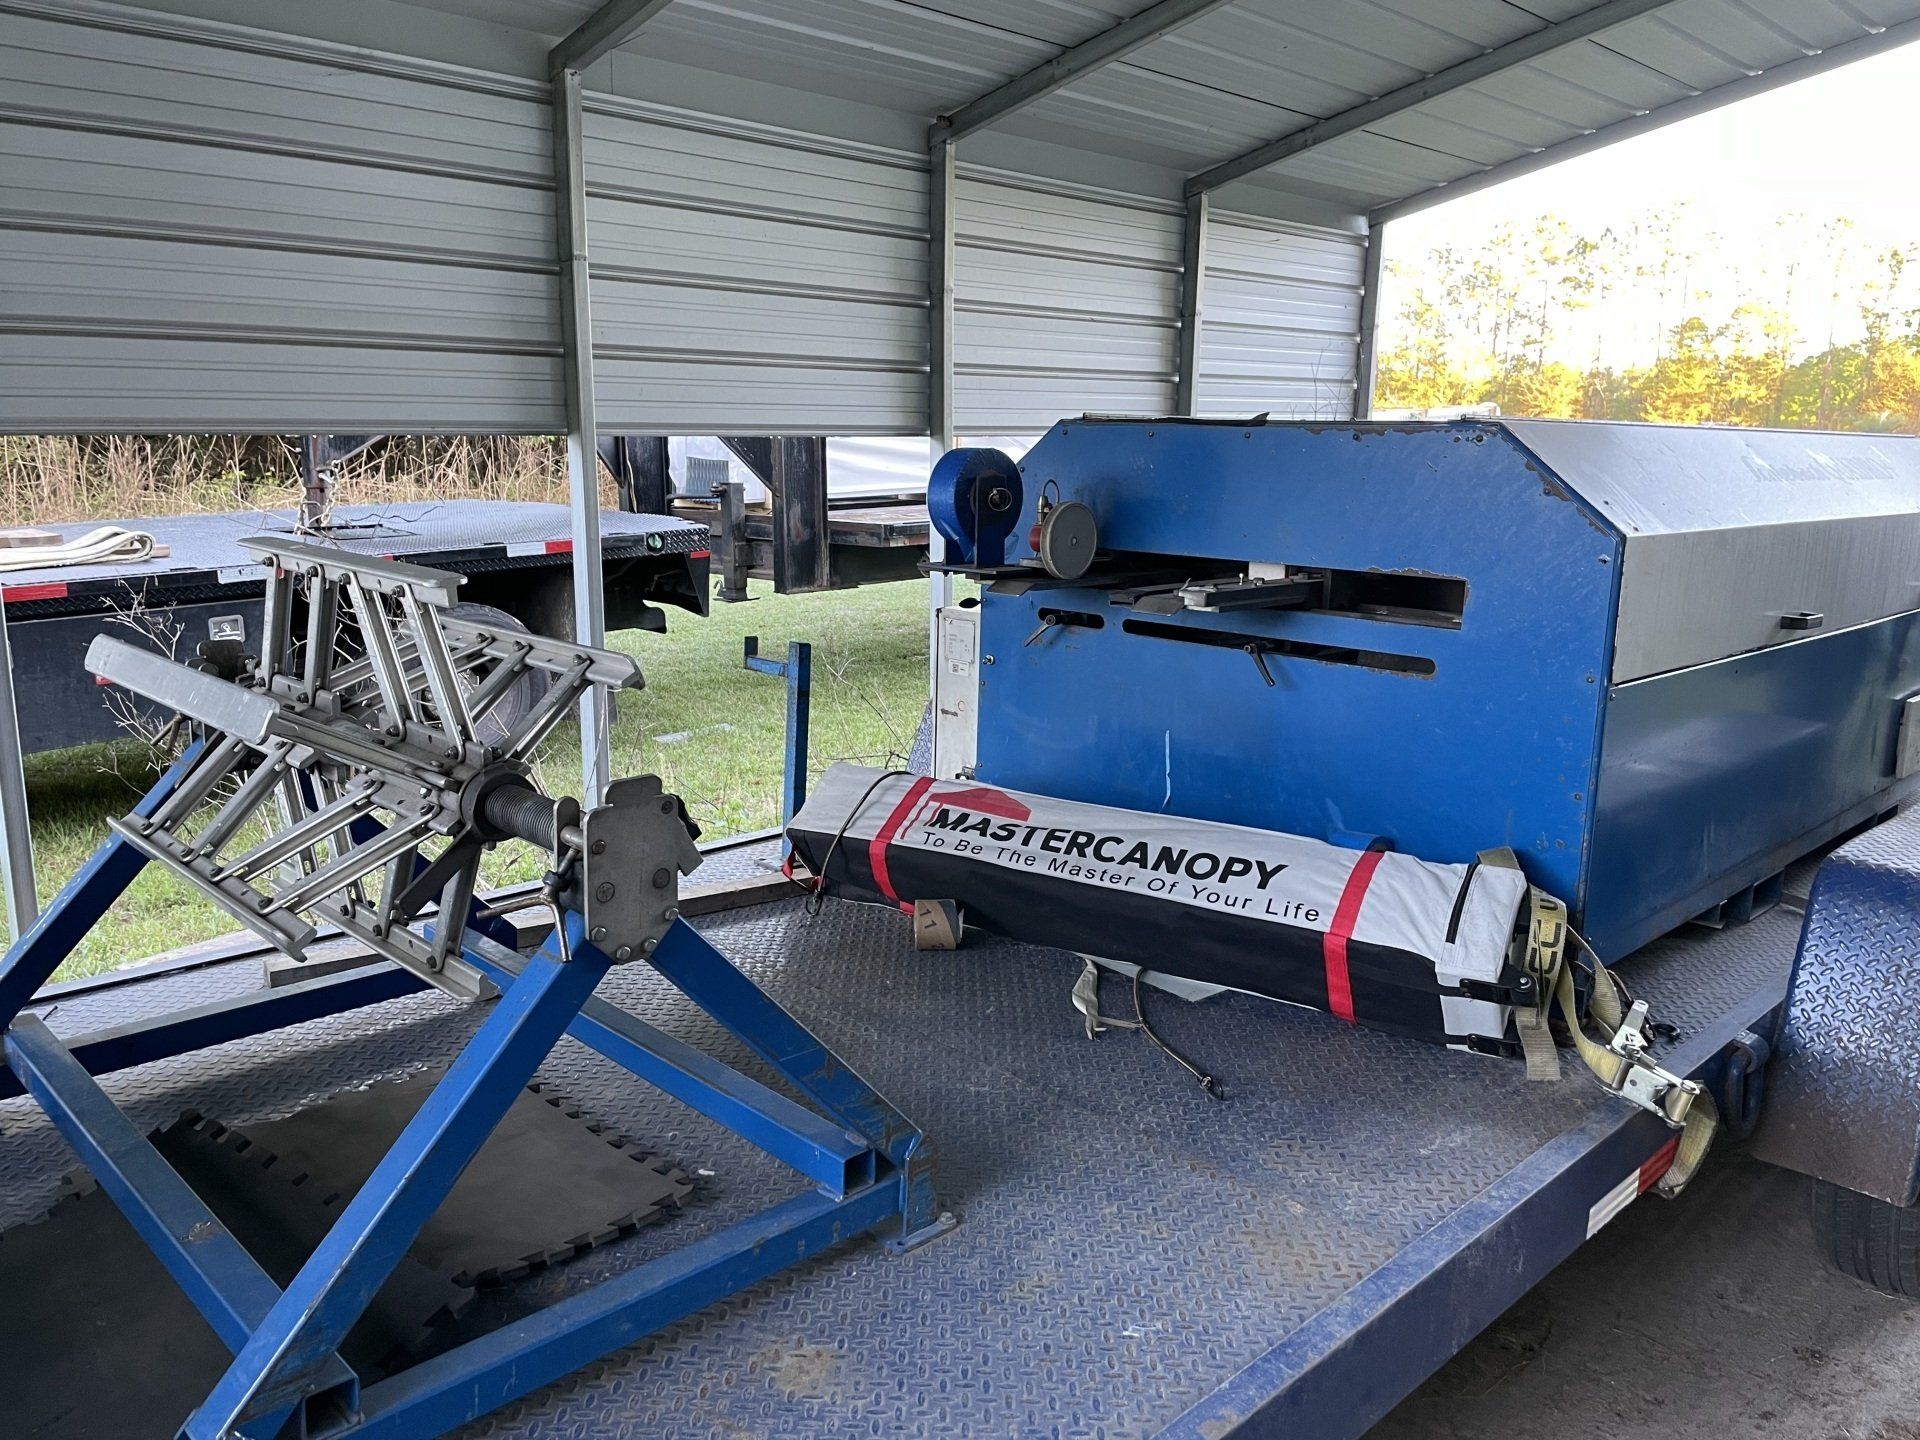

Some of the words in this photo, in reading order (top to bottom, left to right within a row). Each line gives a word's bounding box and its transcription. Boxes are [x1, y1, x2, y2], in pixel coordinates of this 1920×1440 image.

[923, 831, 945, 848] To
[954, 839, 983, 855] Be
[996, 847, 1036, 866] The
[1047, 858, 1136, 886] Master
[1147, 878, 1179, 894] Of
[1191, 884, 1252, 909] Your
[1265, 898, 1320, 922] Life
[929, 808, 1288, 890] MASTERCANOPY
